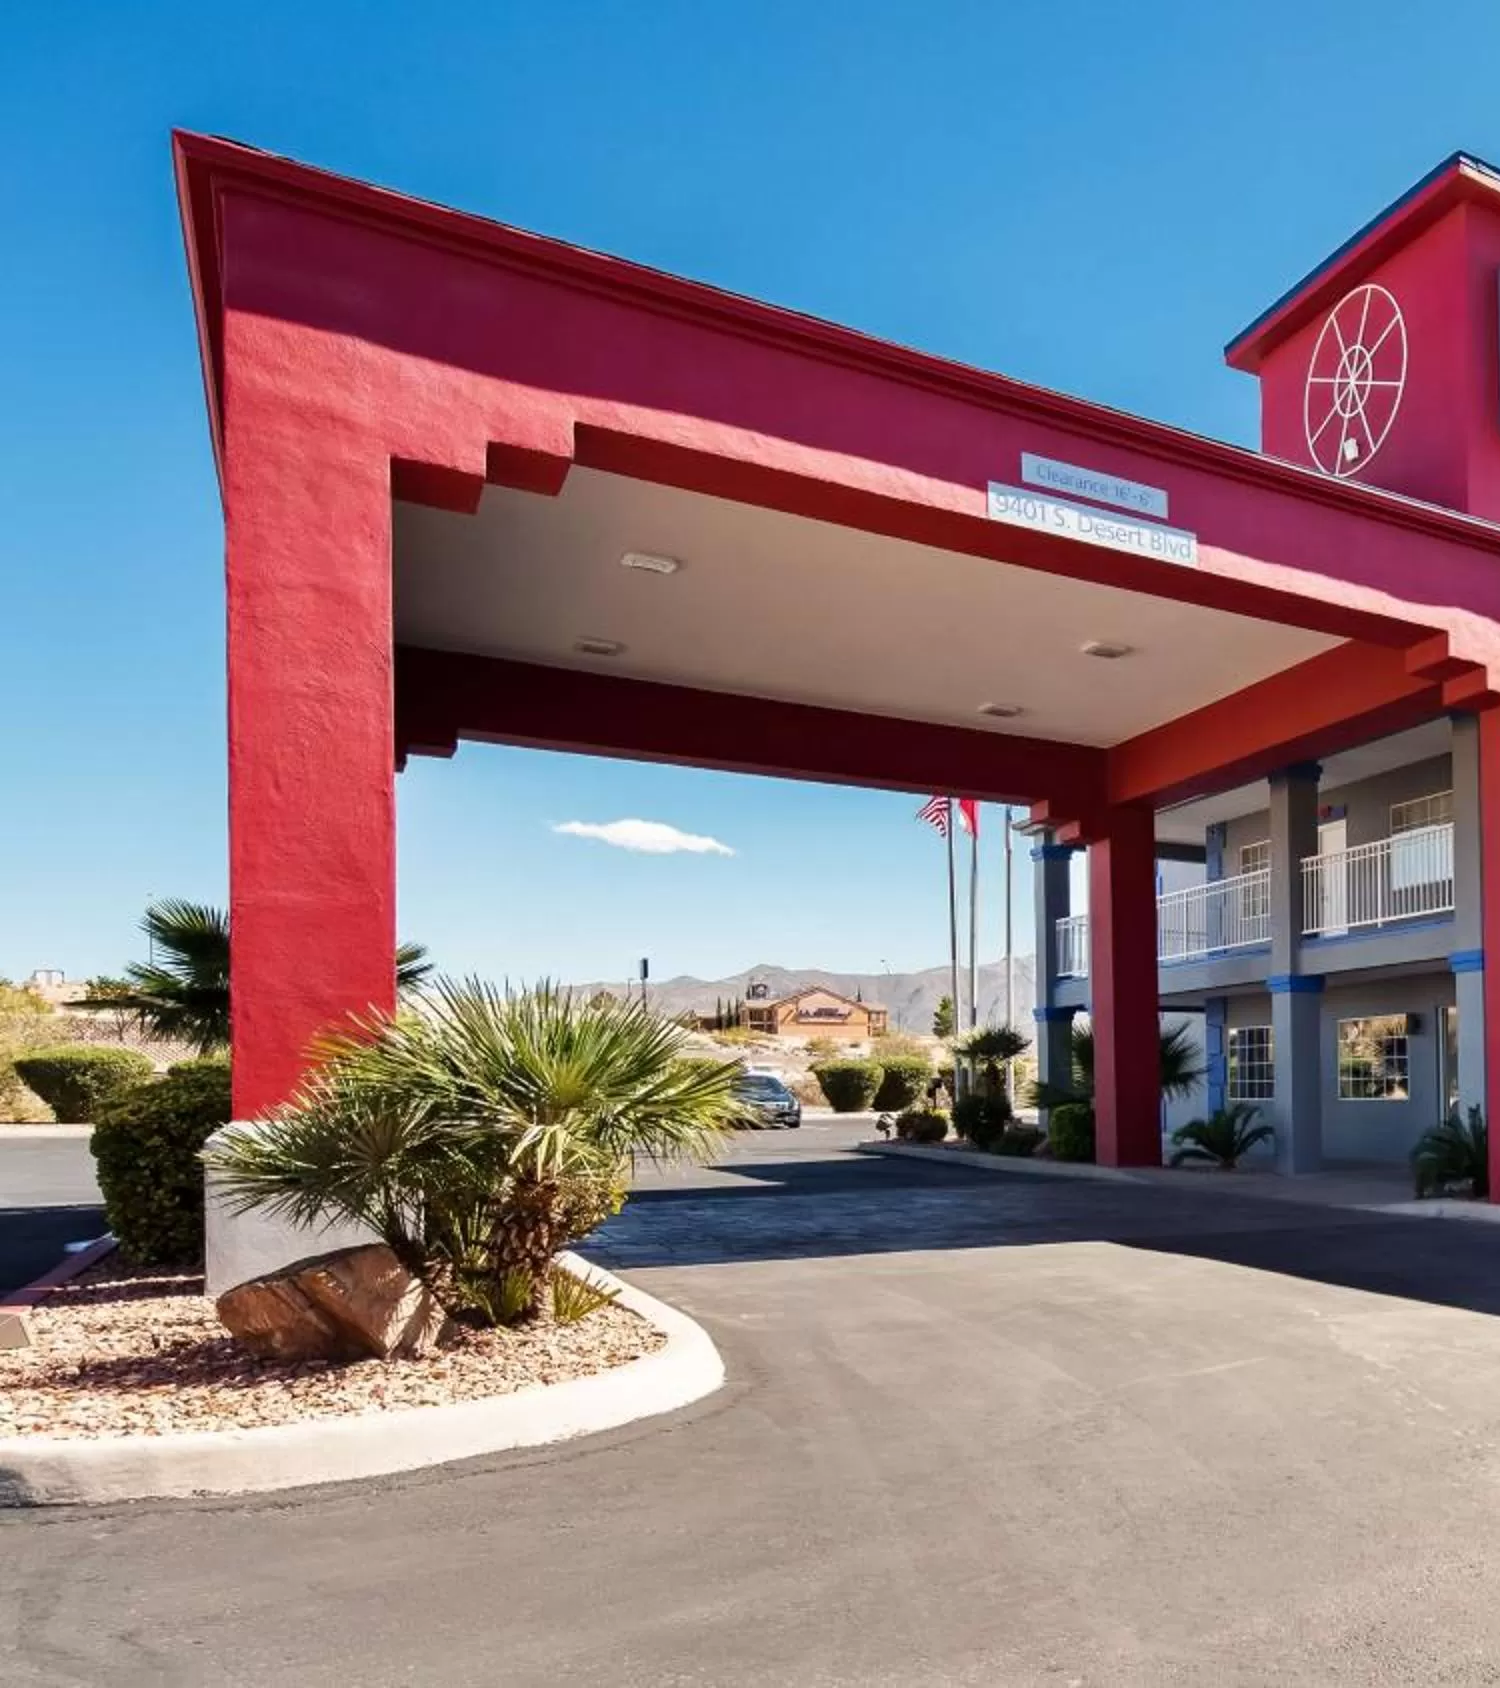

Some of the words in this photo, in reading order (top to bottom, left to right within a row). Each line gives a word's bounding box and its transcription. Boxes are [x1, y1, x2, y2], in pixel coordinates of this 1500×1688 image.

[1036, 463, 1109, 496] Clearance
[996, 494, 1046, 522] 9401
[1054, 506, 1072, 529] S.
[1078, 513, 1145, 548] Desert
[1151, 531, 1191, 560] Blvd
